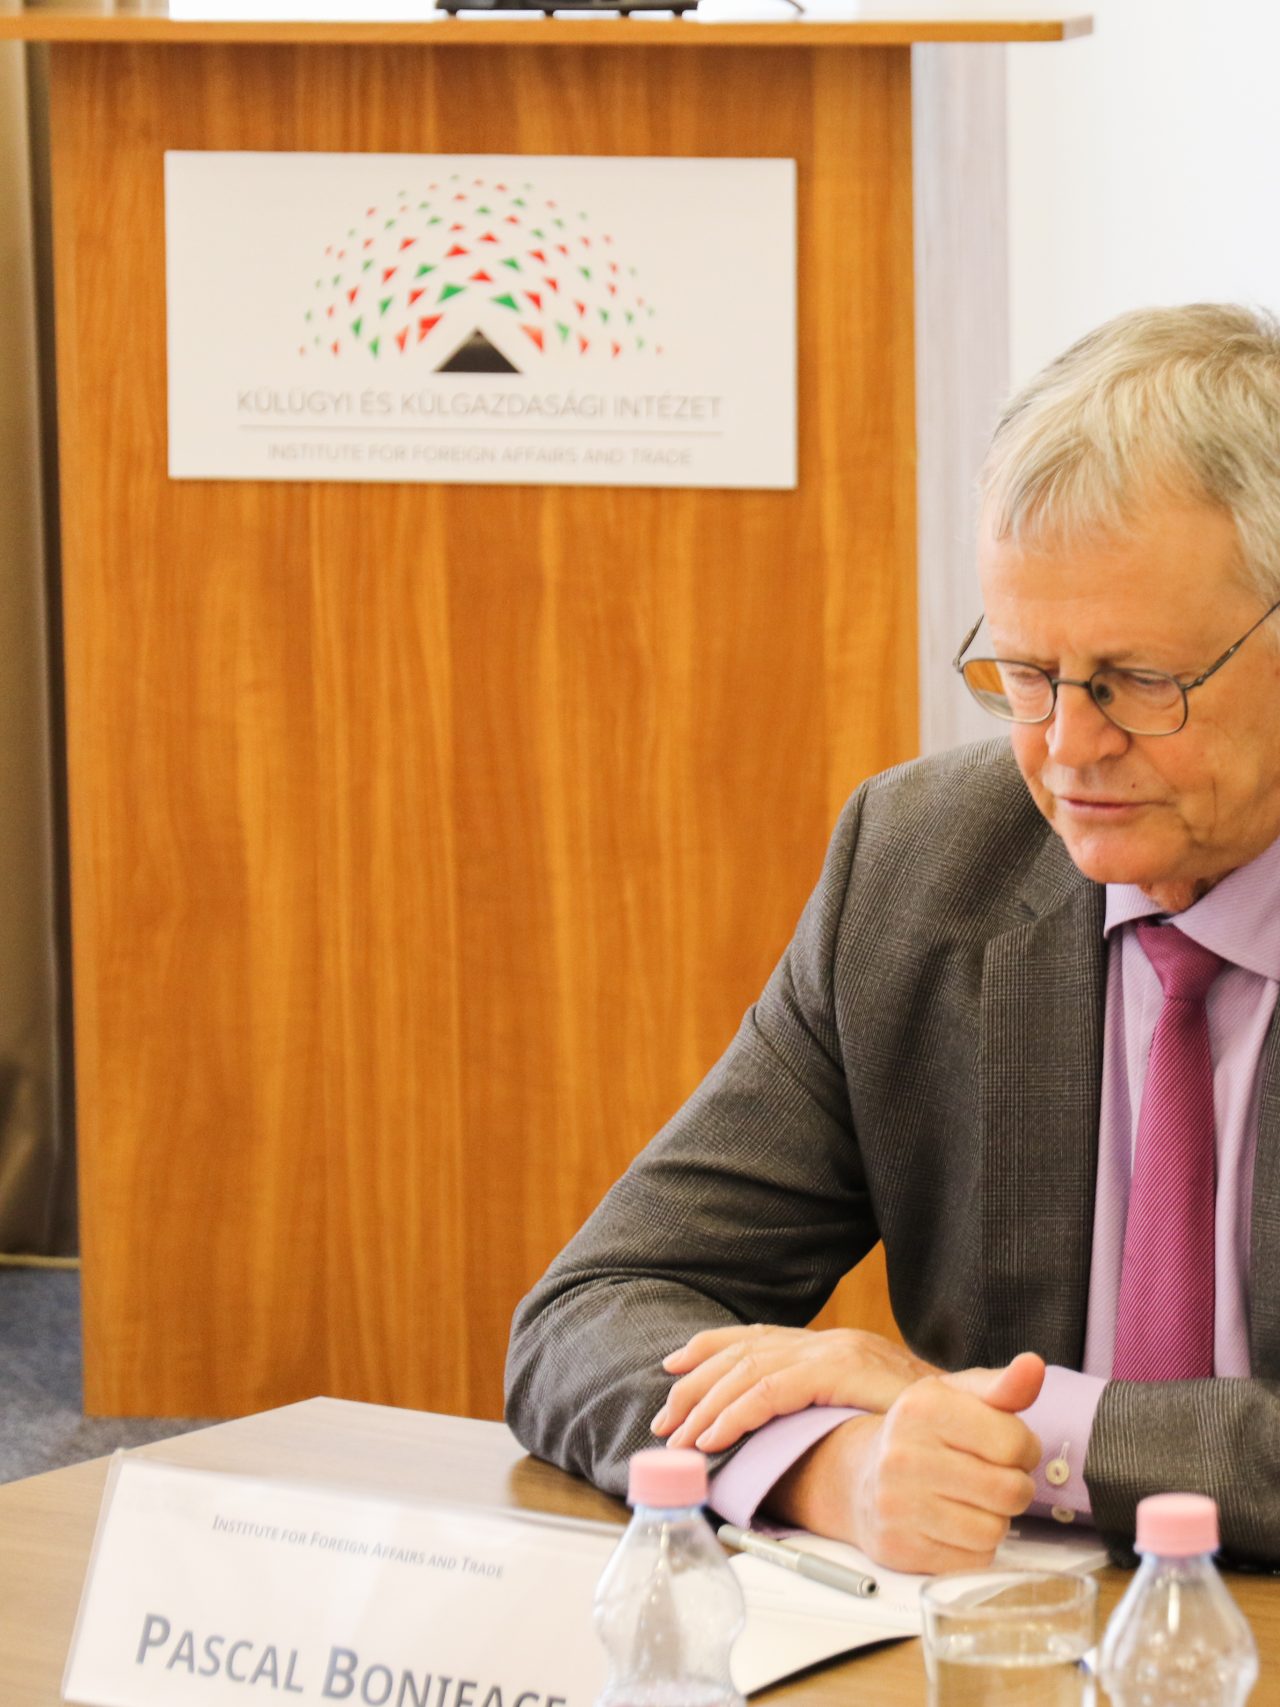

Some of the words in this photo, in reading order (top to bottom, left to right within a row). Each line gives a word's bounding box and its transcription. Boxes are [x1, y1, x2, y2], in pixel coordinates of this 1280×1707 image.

[237, 386, 351, 414] KÜLÜGYI
[359, 386, 393, 415] ÉS
[401, 387, 607, 417] KÜLGAZDASÁGI
[613, 389, 722, 419] INTÉZET
[267, 442, 362, 460] INSTITUTE
[367, 443, 406, 461] FOR
[411, 444, 495, 464] FOREIGN
[501, 445, 576, 465] AFFAIRS
[582, 447, 623, 465] AND
[631, 447, 692, 466] TRADE
[135, 1613, 305, 1693] PASCAL
